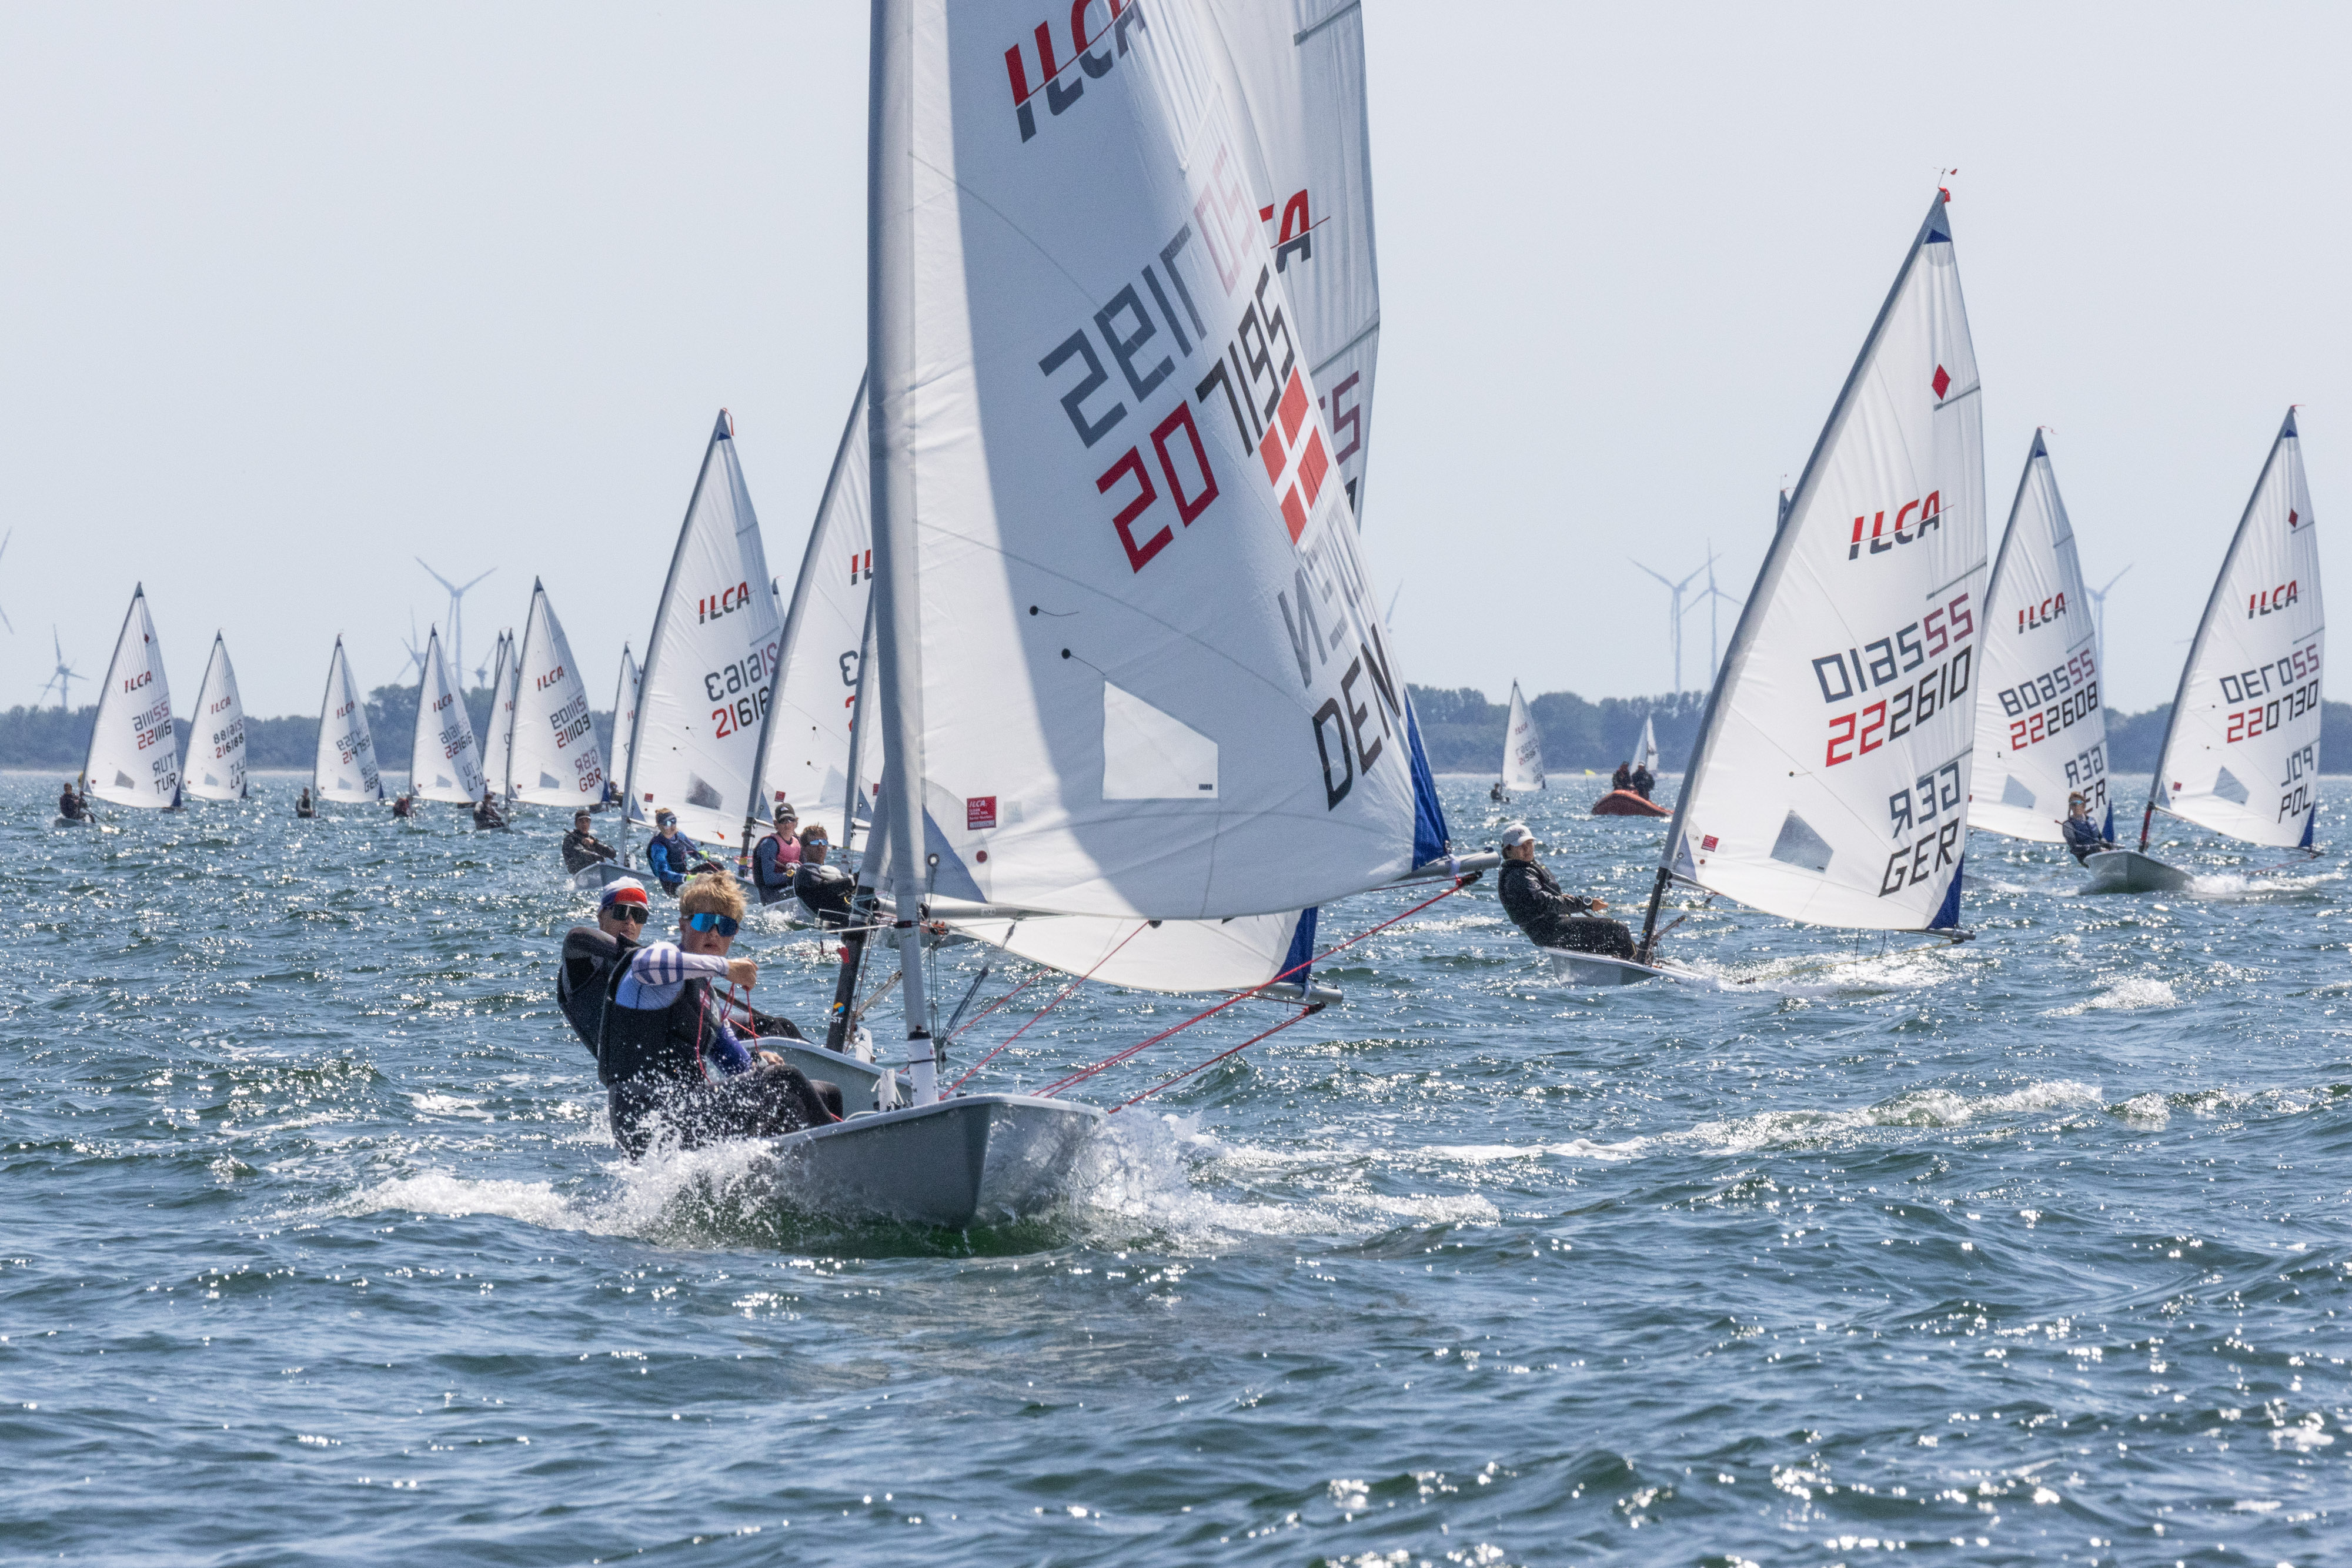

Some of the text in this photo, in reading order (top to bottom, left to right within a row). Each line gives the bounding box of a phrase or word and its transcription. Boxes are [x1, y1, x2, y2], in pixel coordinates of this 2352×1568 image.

[1095, 262, 1295, 574] 207195
[1849, 490, 1940, 560] ILCA
[851, 549, 873, 586] IL
[699, 581, 750, 624] ILCA
[2019, 591, 2067, 634] ILCA
[2248, 580, 2298, 619] ILCA
[125, 670, 152, 693] ILCA
[537, 666, 564, 691] ILCA
[211, 696, 230, 715] ILCA
[336, 700, 355, 719] ILCA
[433, 693, 453, 713] ILCA
[1312, 623, 1401, 811] DEN
[1826, 644, 1972, 767] 222610
[2010, 680, 2099, 751] 222608
[2227, 679, 2319, 743] 220730
[136, 719, 172, 750] 221116
[555, 713, 591, 748] 211109
[154, 773, 176, 794] TUR
[230, 771, 245, 789] LAT
[365, 773, 379, 793] GER
[467, 772, 485, 791] LTU
[579, 767, 603, 792] GBR
[2083, 778, 2106, 809] ER
[2278, 783, 2311, 824] POL
[1878, 817, 1960, 898] GER
